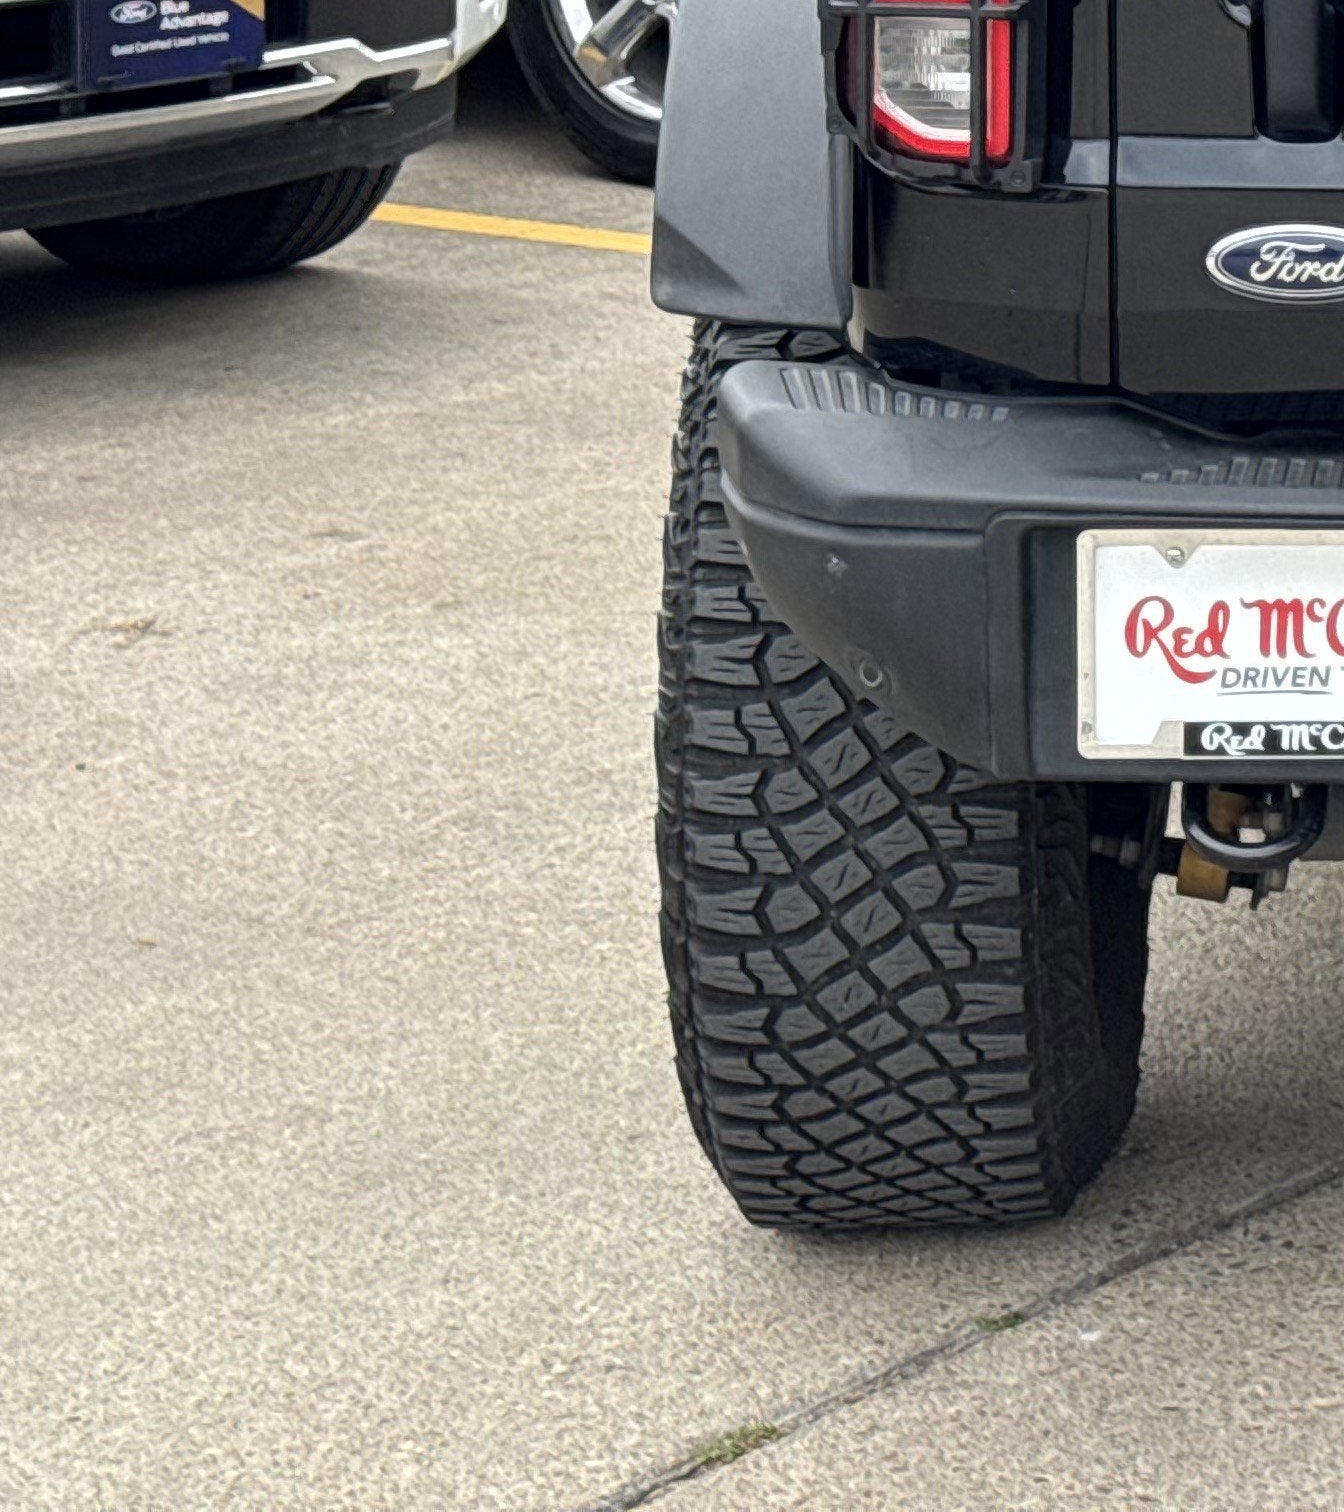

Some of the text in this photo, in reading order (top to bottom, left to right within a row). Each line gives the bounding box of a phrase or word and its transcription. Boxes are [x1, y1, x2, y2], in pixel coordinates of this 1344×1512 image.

[1124, 595, 1231, 684] Red
[1220, 665, 1333, 688] DRIVEN
[1201, 722, 1266, 756] Red
